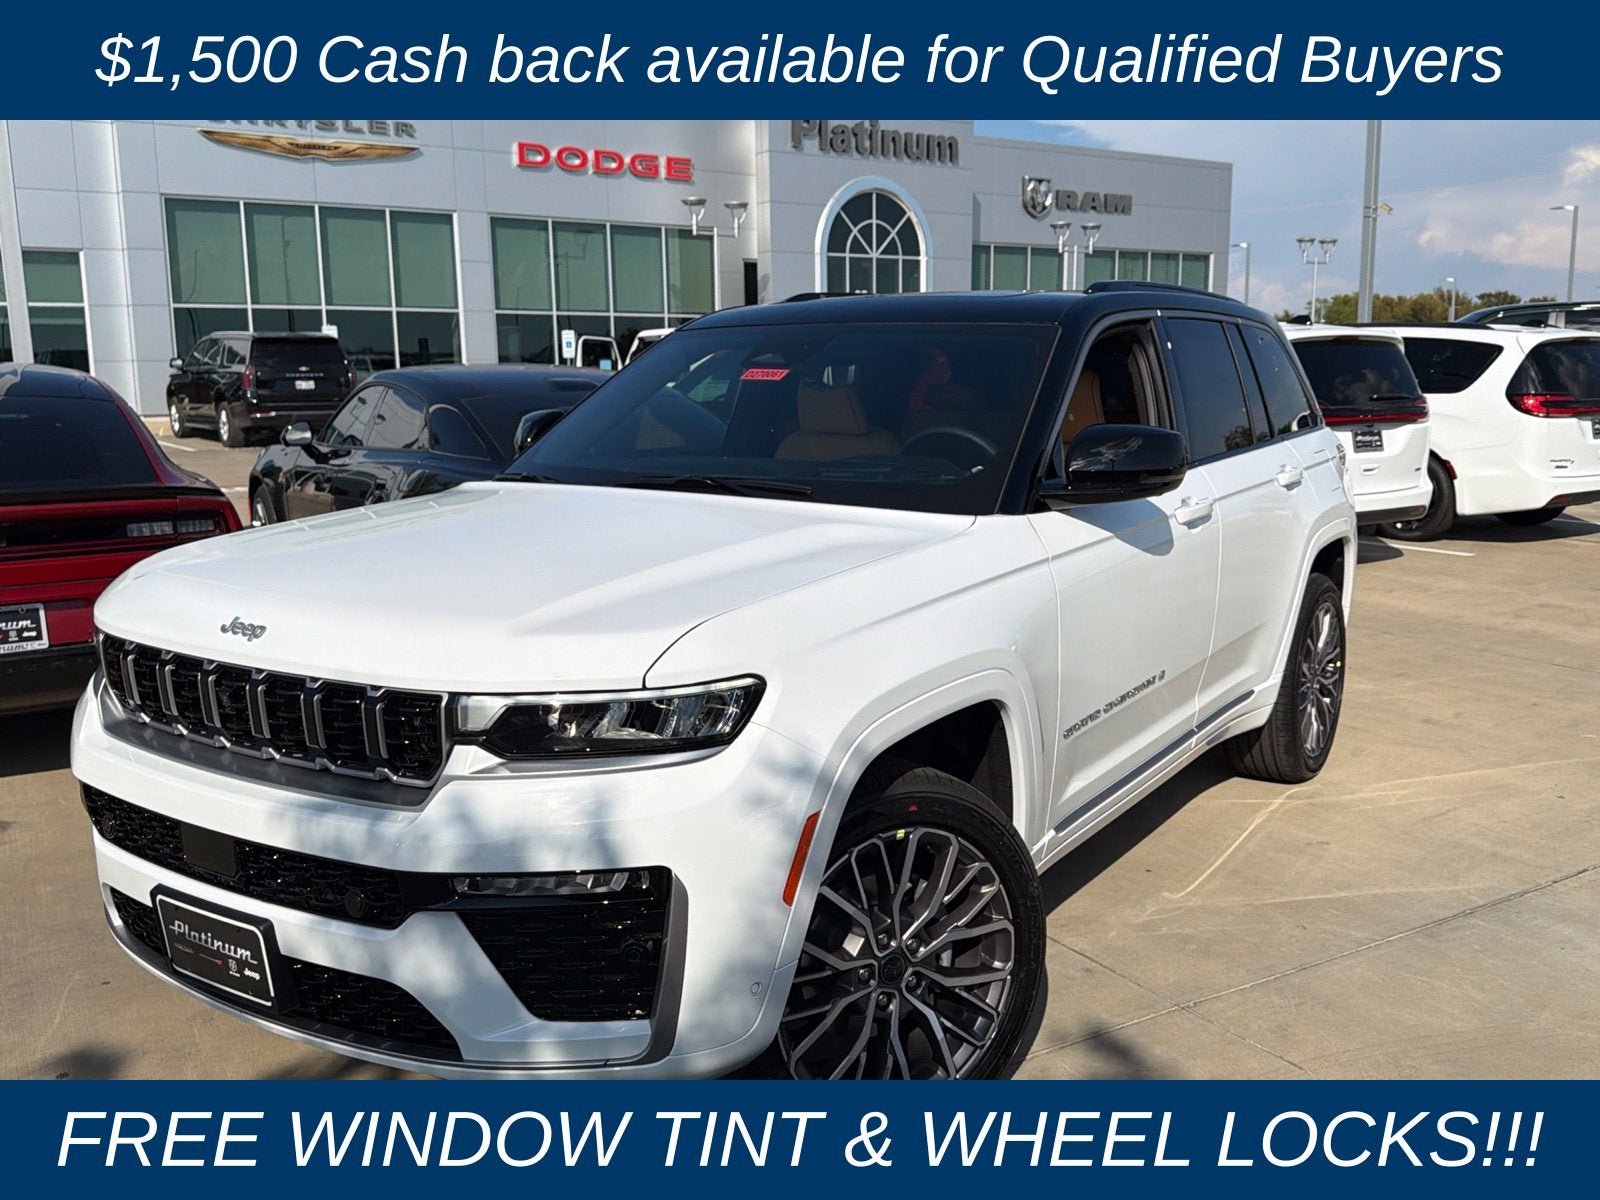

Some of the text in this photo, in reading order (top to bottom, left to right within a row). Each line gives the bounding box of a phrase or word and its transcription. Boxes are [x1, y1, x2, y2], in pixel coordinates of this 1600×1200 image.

[513, 141, 693, 182] DODGE
[790, 120, 959, 164] Platinum
[1055, 189, 1132, 215] RAM
[220, 616, 267, 642] Jeep
[169, 920, 258, 964] Platinum
